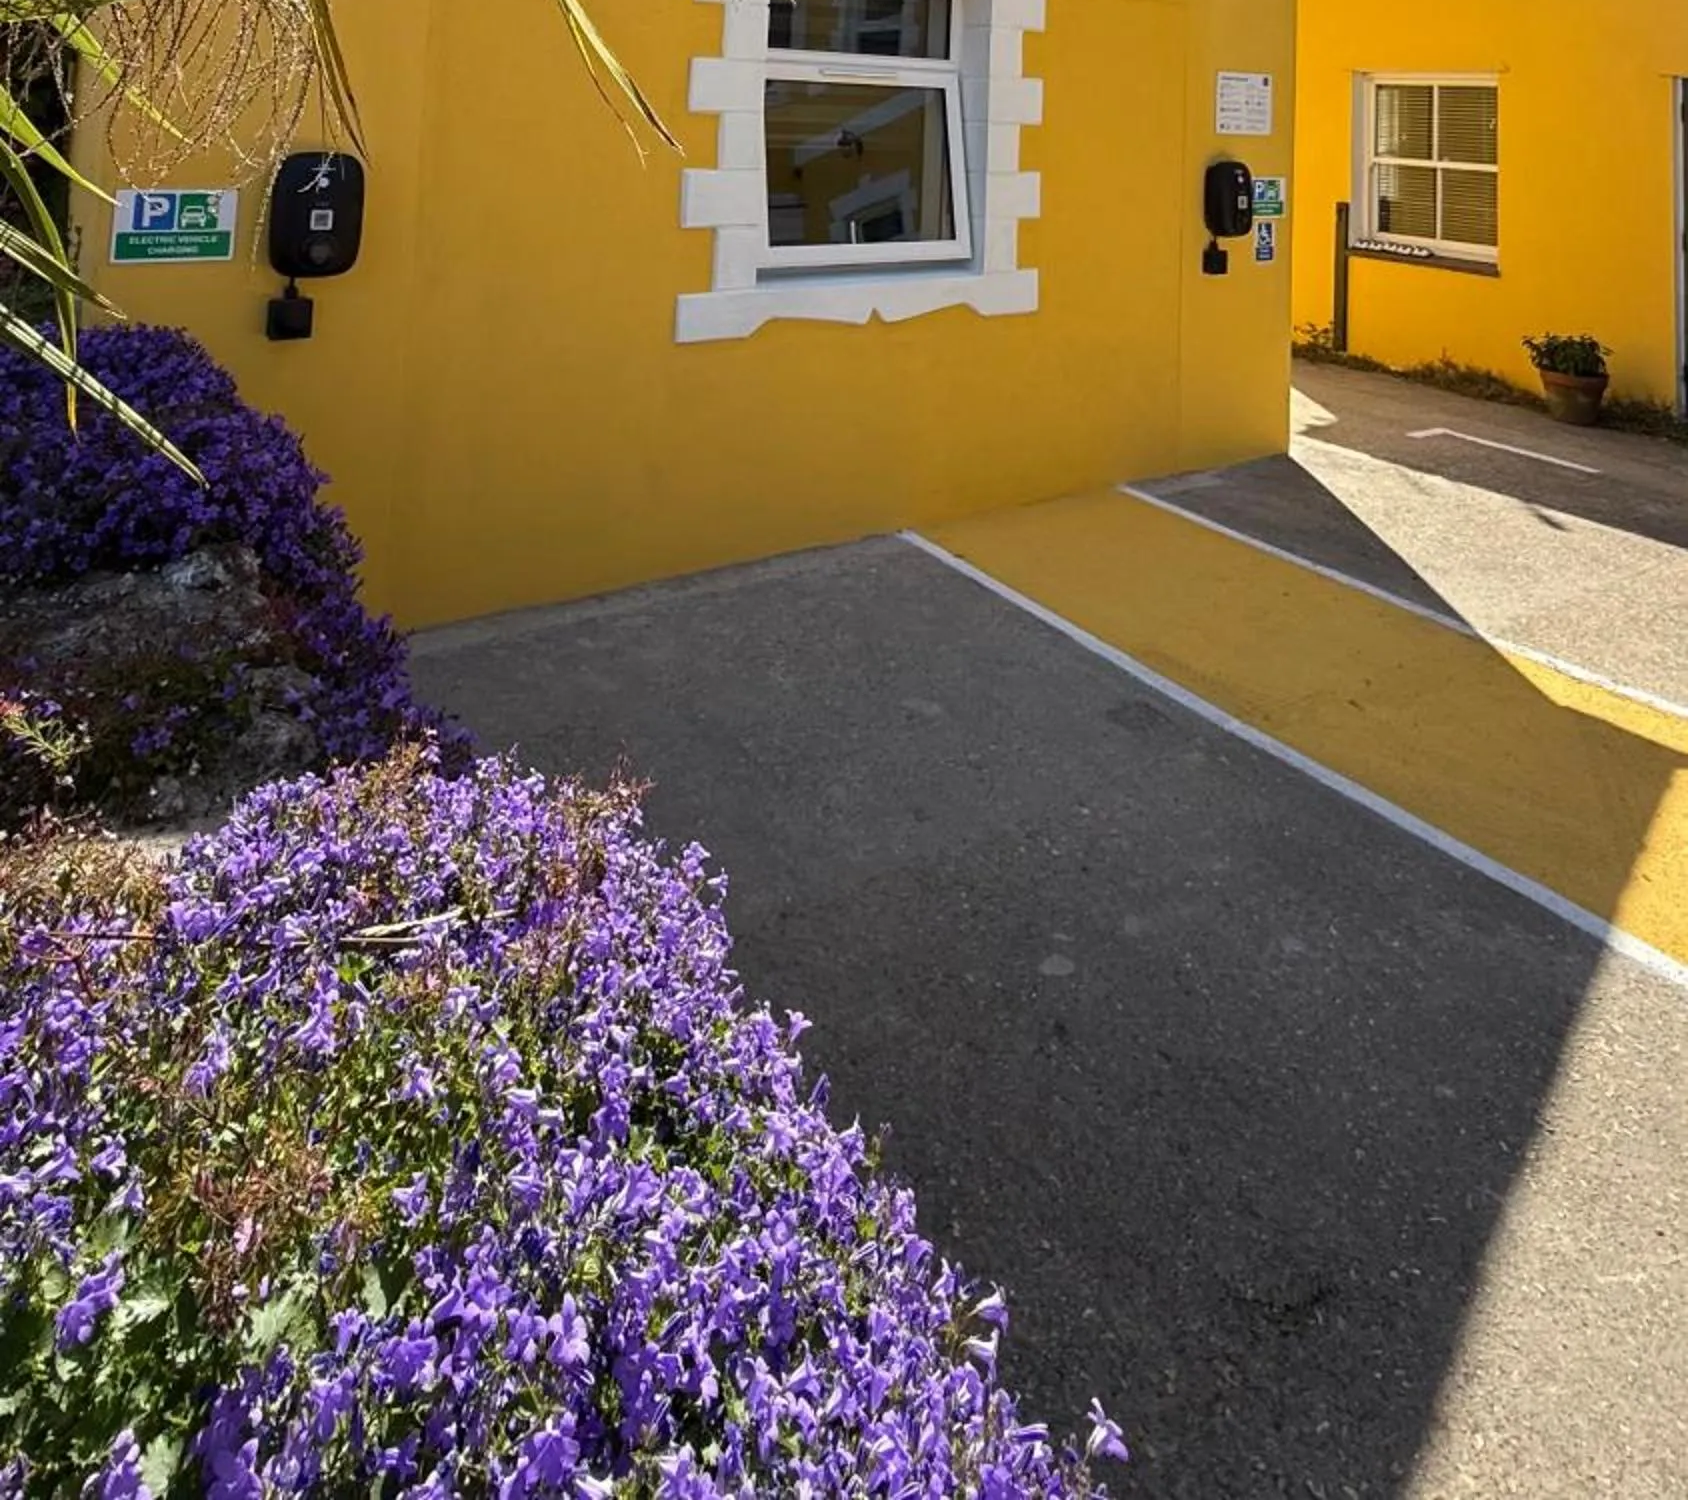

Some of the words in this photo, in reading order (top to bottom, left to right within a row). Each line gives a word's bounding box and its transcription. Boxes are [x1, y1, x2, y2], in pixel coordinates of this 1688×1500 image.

[142, 196, 170, 228] P
[129, 236, 174, 245] ELECTRIC
[178, 235, 218, 243] VEHICLE
[147, 246, 199, 255] CHARGING
